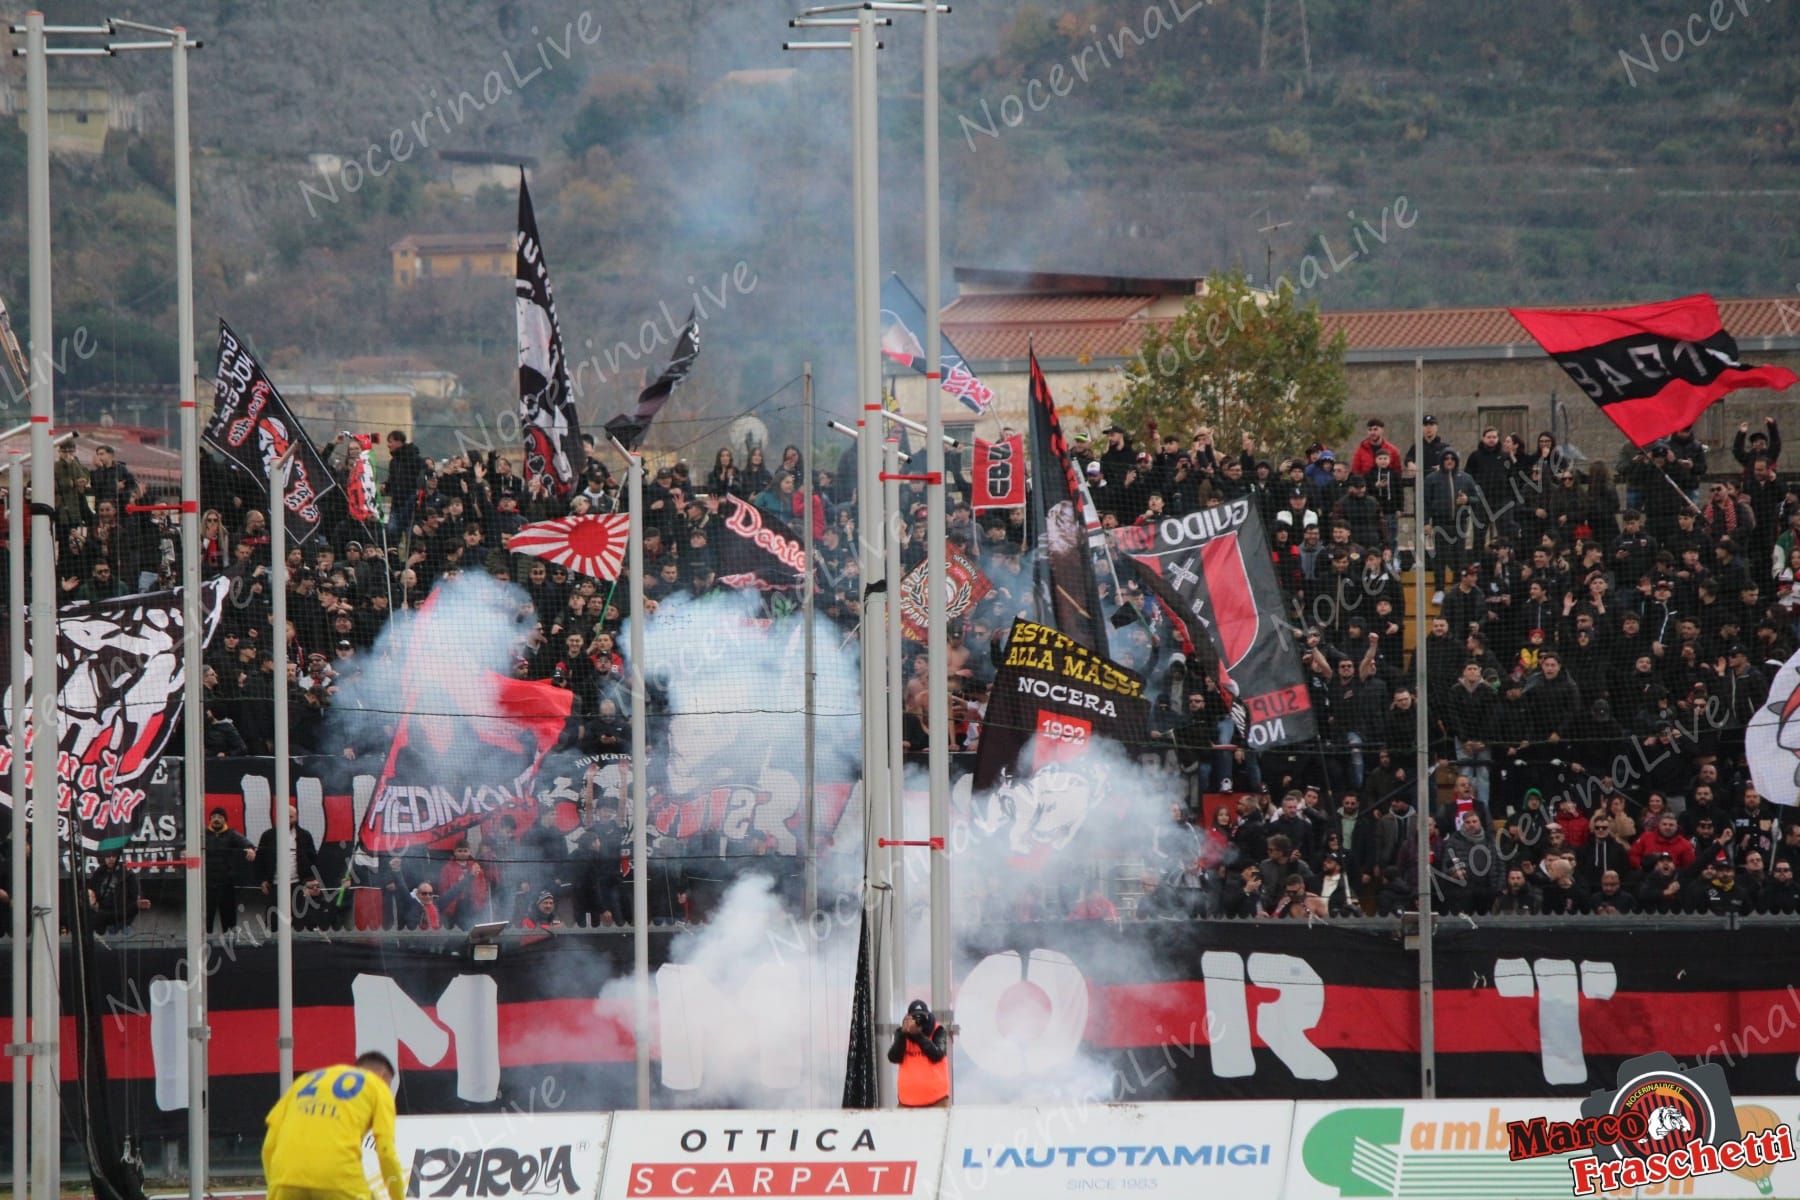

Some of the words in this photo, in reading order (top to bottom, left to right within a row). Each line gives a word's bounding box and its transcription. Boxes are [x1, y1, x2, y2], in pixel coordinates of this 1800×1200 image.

[1005, 646, 1055, 672] ALLA
[1017, 675, 1118, 719] NOCERA
[1041, 719, 1086, 746] 1992
[150, 948, 1800, 1112] IMMORT
[297, 1071, 366, 1101] 20
[680, 1128, 877, 1152] OTTICA
[962, 1144, 1271, 1169] L'AUTOTAMIGI
[407, 1144, 581, 1198] PAROLA
[633, 1165, 912, 1196] SCARPATI
[1066, 1178, 1116, 1190] SINCE
